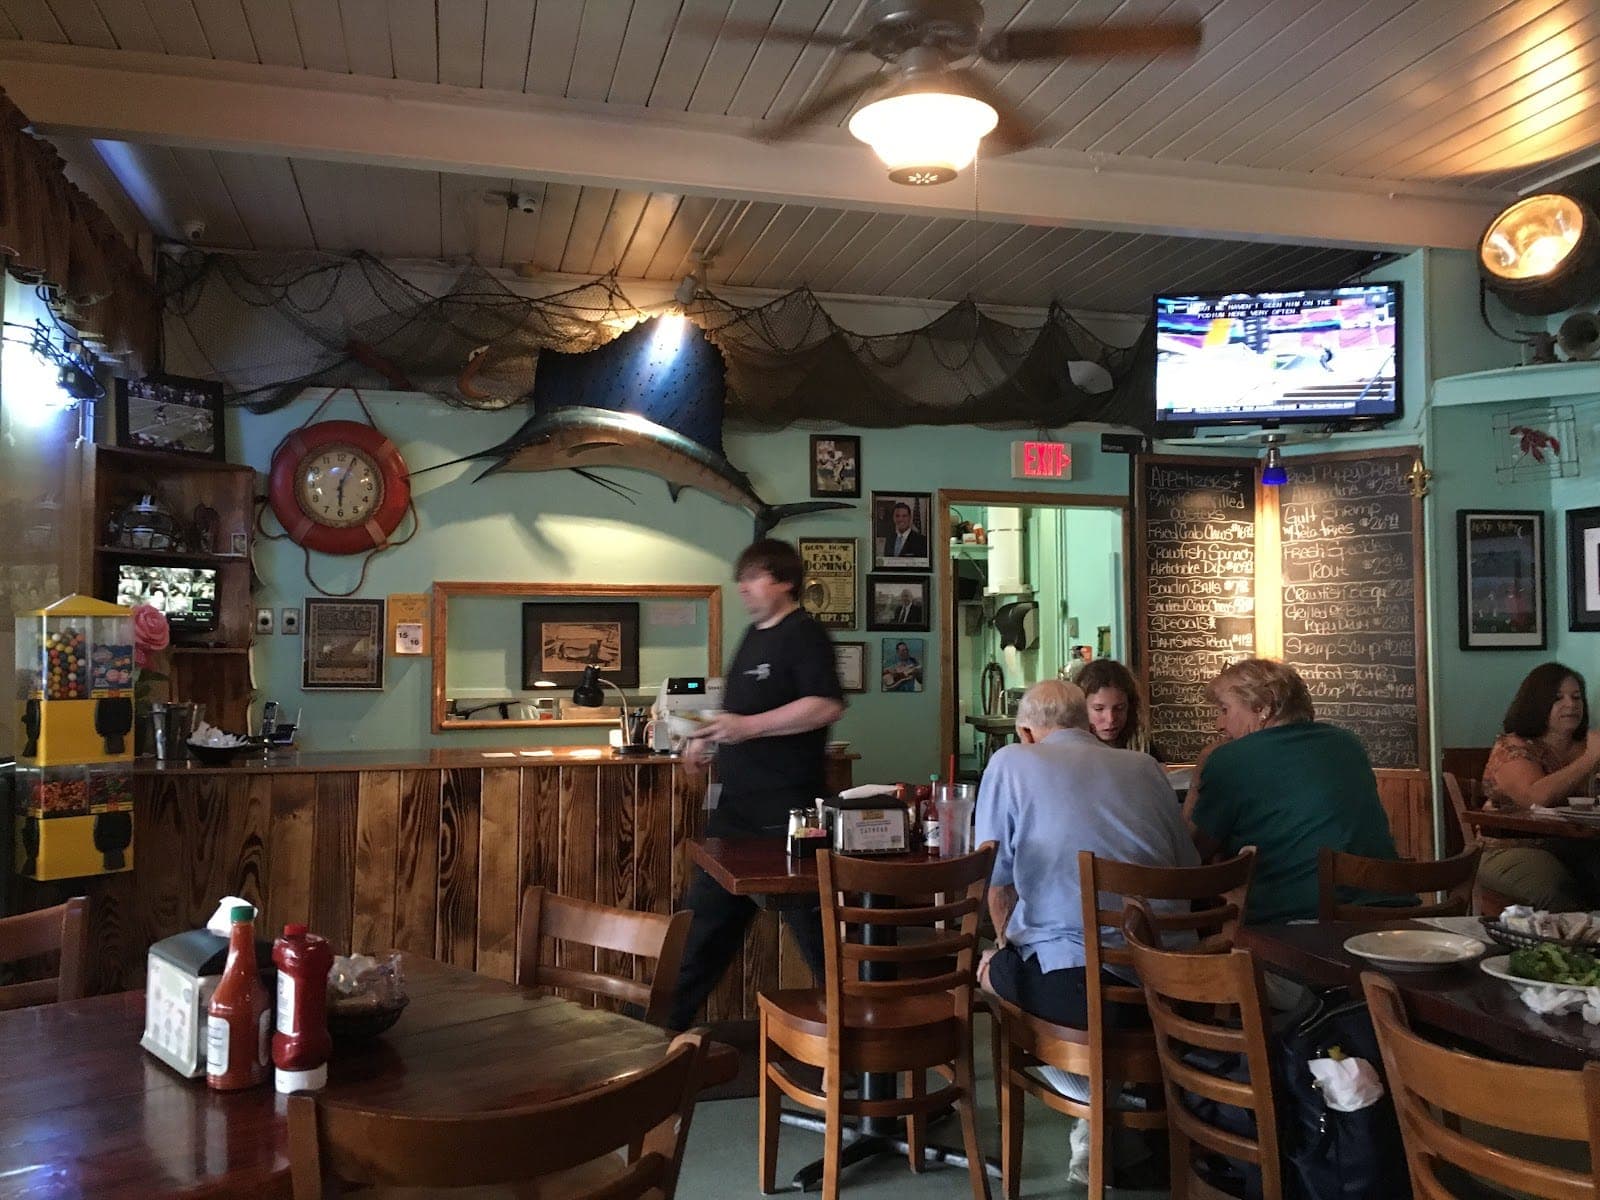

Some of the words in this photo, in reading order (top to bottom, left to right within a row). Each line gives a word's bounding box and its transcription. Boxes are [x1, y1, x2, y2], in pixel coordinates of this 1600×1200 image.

[322, 456, 330, 464] 11
[337, 453, 346, 462] 12
[1024, 442, 1065, 476] EXIT
[367, 482, 373, 491] 3
[337, 509, 344, 517] 6
[813, 553, 842, 561] FATS
[803, 560, 852, 571] DOMINO
